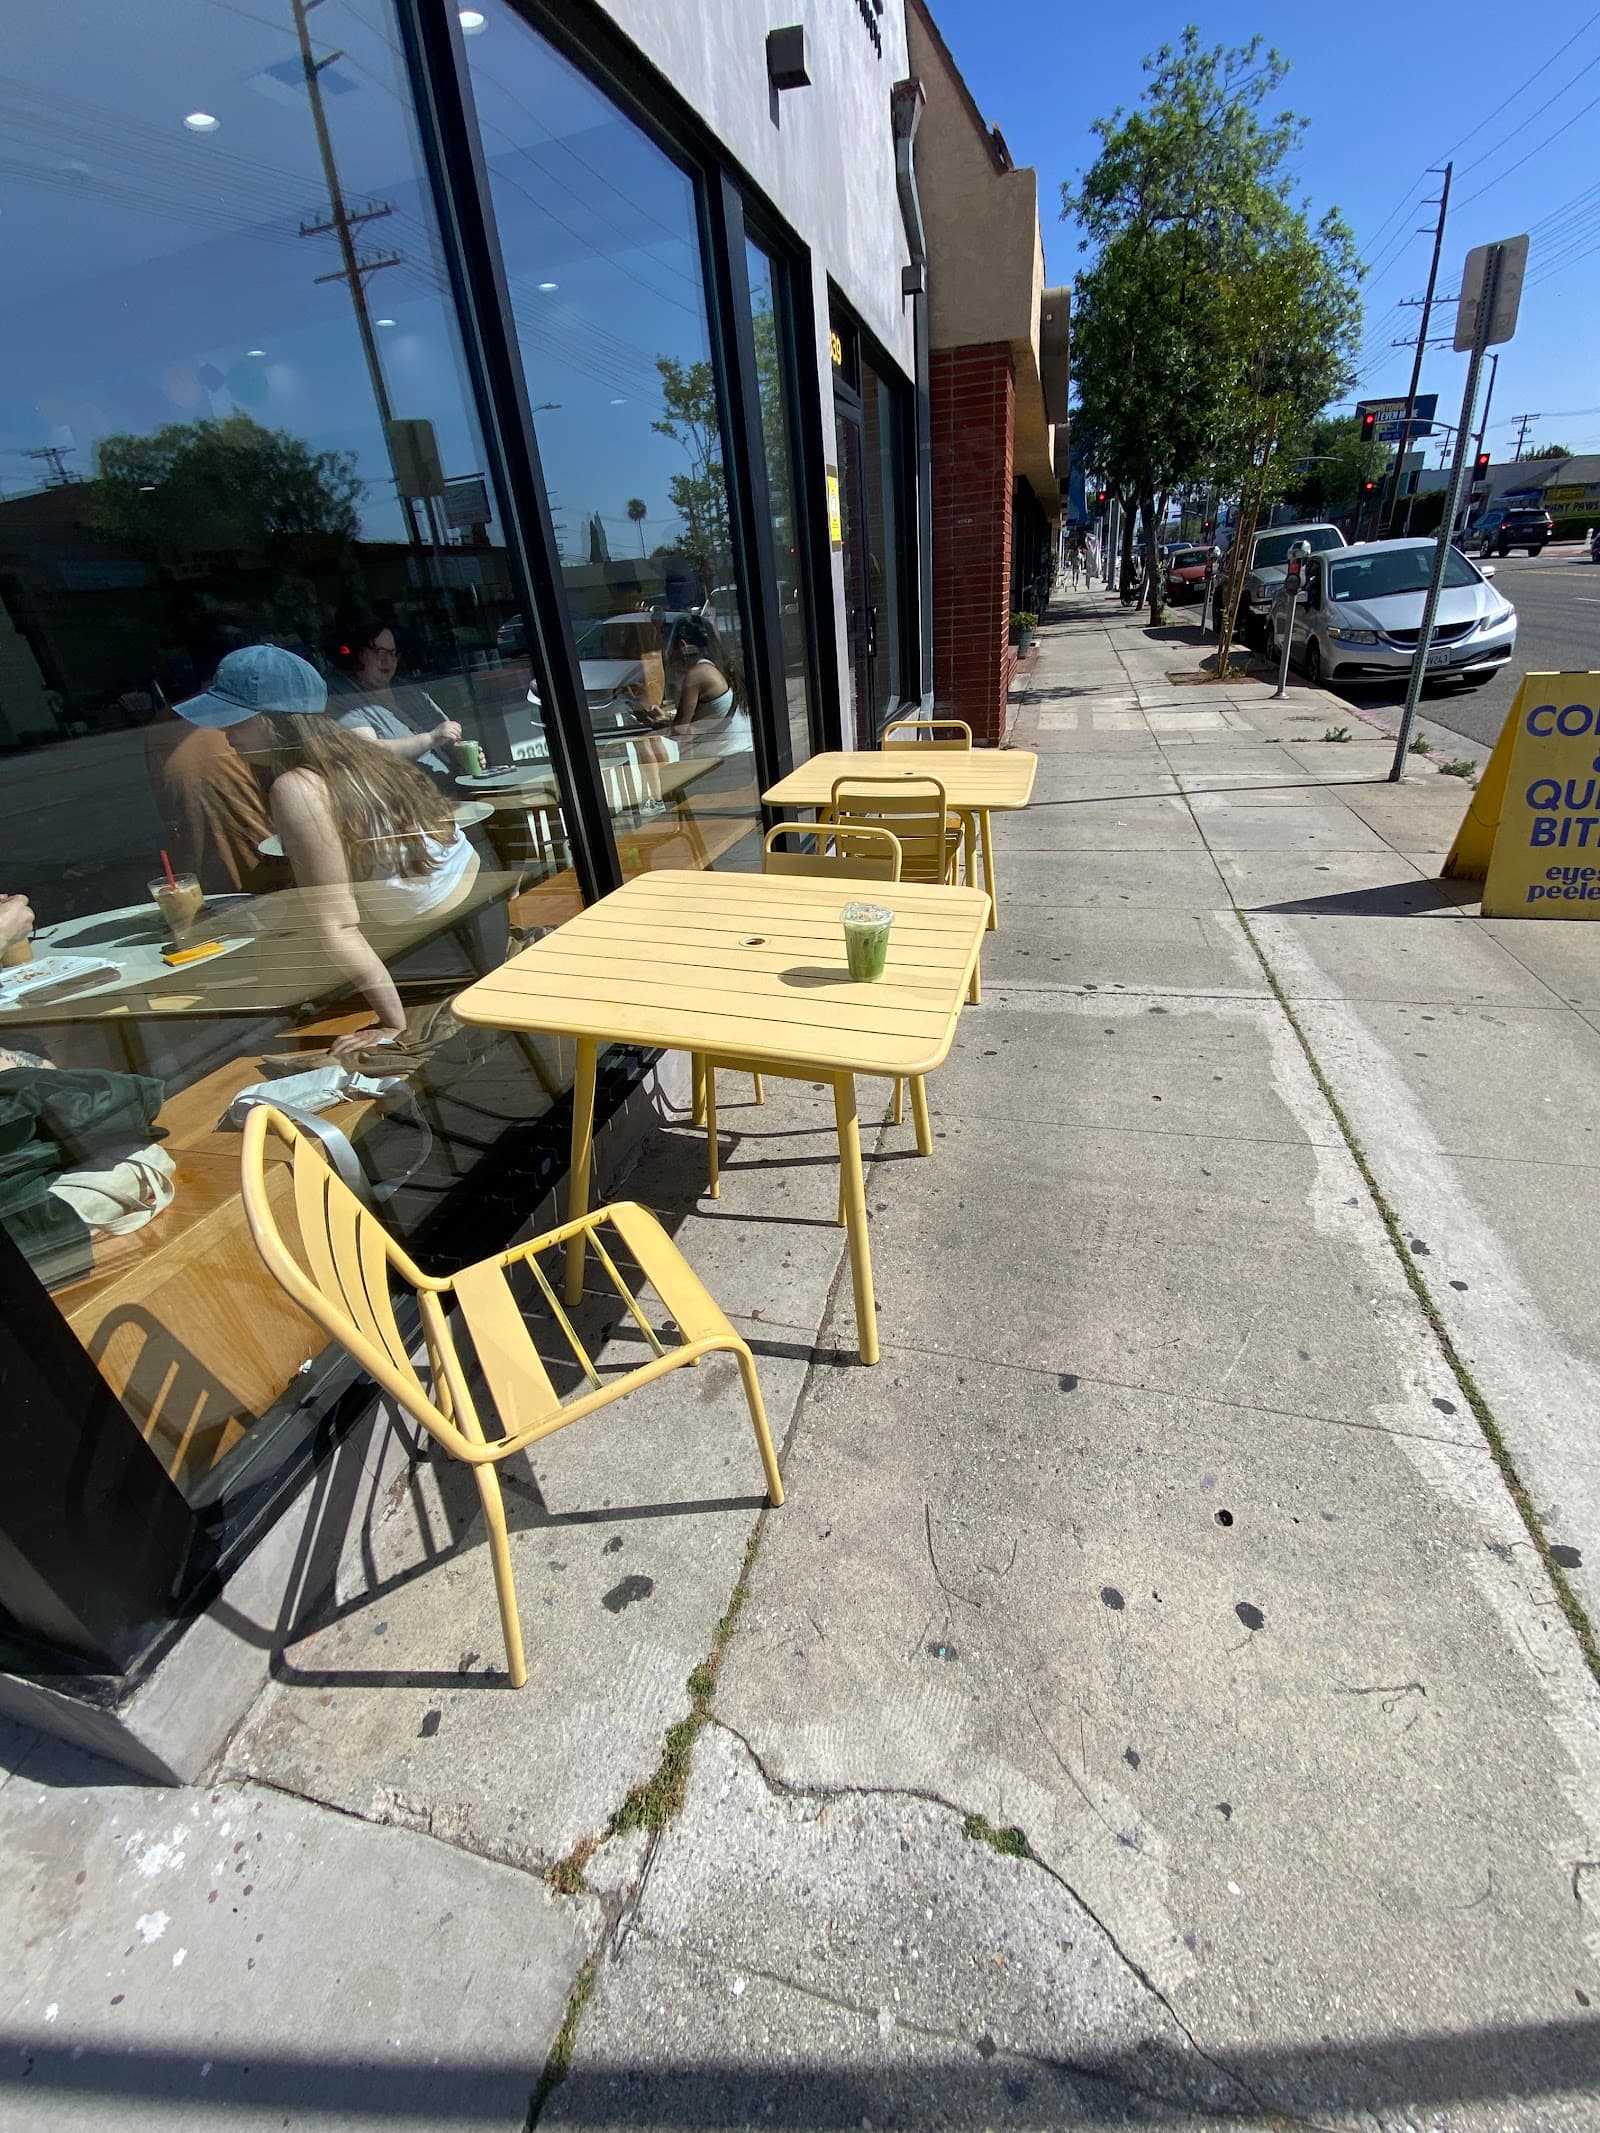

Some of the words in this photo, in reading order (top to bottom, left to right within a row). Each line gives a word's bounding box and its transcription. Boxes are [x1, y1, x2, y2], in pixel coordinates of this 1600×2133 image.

[1526, 704, 1600, 737] CO
[1526, 779, 1600, 811] QU
[1530, 817, 1600, 848] BIT
